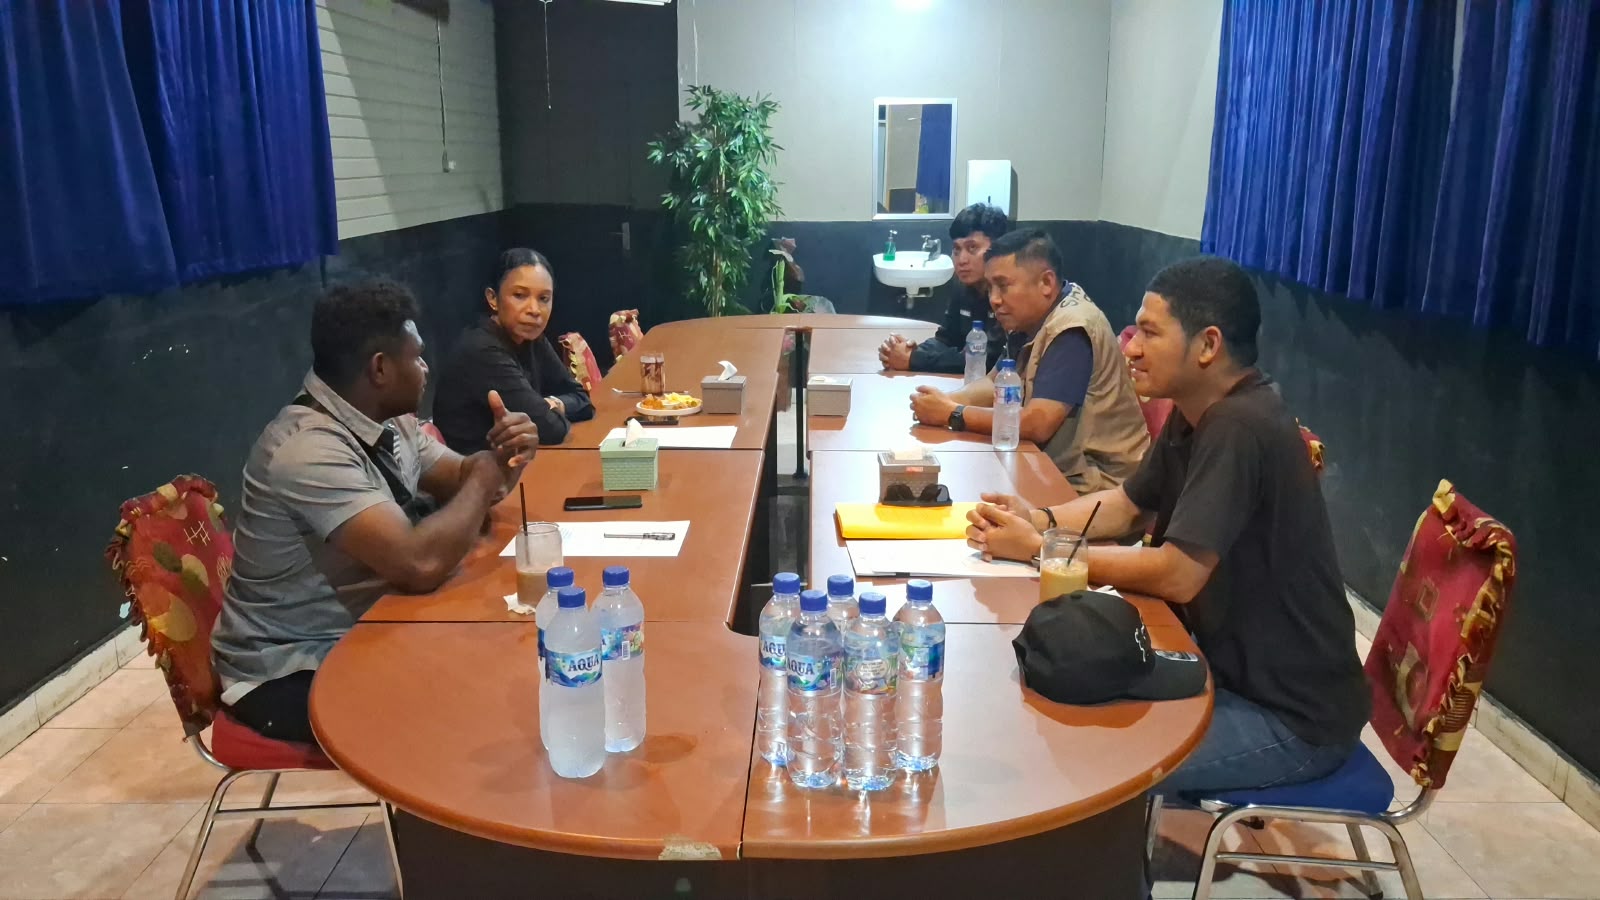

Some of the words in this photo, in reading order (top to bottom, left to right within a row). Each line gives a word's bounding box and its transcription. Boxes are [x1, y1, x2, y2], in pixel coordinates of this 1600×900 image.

[763, 641, 786, 657] AQU
[568, 654, 600, 672] AQUA
[787, 657, 815, 676] AQUA
